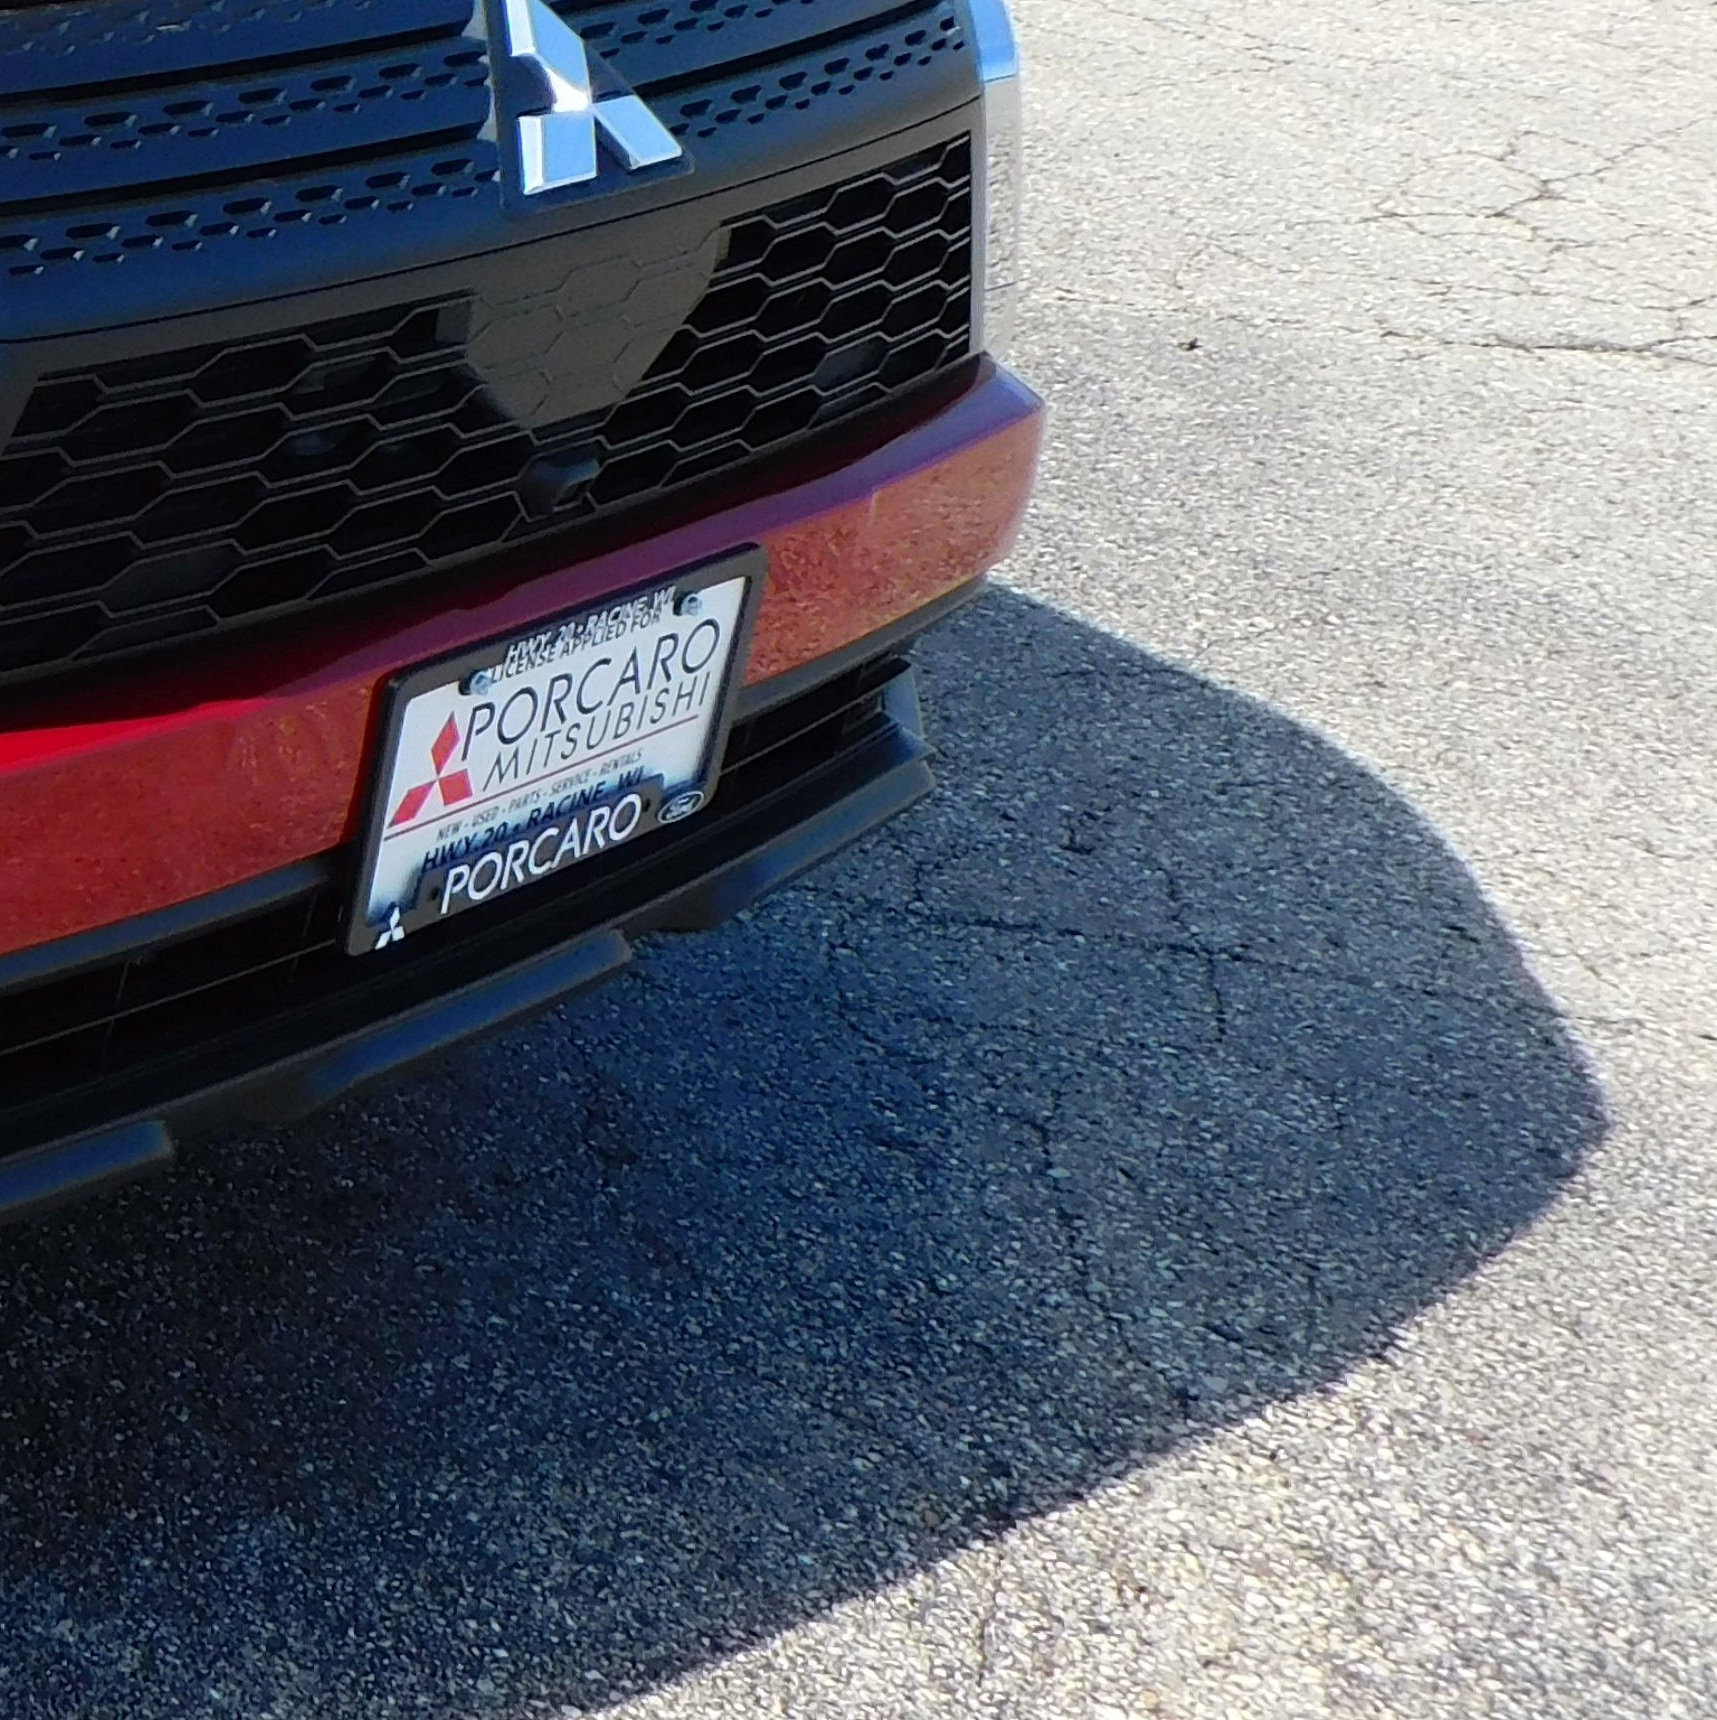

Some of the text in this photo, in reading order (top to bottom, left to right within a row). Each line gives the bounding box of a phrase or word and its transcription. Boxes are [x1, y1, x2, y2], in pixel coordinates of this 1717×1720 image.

[461, 618, 721, 762] PORCARO
[559, 620, 627, 659] APPLIED
[630, 608, 660, 632] FOR
[482, 671, 711, 792] MITSUBISHI
[440, 793, 642, 915] PORCARO
